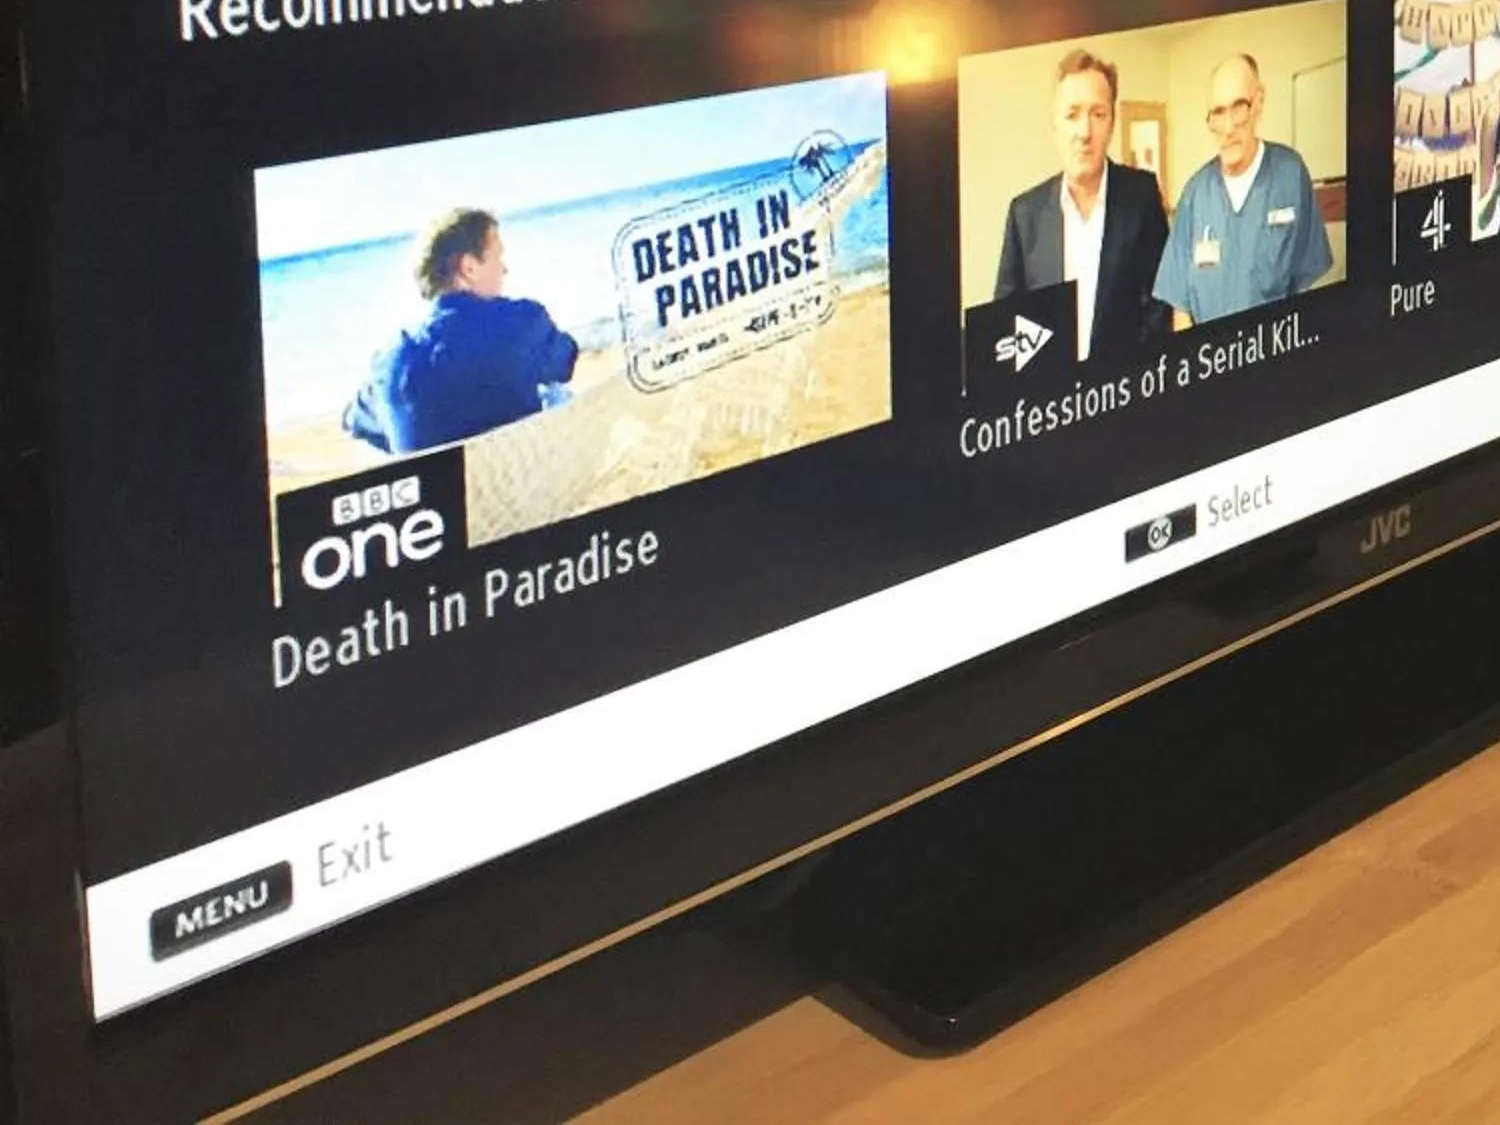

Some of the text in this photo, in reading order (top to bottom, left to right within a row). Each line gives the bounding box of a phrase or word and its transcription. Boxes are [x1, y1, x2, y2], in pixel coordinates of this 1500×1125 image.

[631, 189, 791, 284] DEATH IN
[1419, 188, 1452, 252] 4
[654, 229, 821, 328] PARADISE
[1391, 279, 1435, 316] Pure
[959, 376, 1131, 458] Confessions
[1140, 354, 1168, 399] of
[1177, 358, 1190, 387] a
[1198, 324, 1265, 381] Serial
[337, 478, 420, 524] BBC
[1150, 474, 1274, 545] OK Select
[1359, 502, 1413, 555] JVC
[301, 507, 445, 590] one
[271, 529, 660, 689] Death in Paradise
[174, 820, 393, 939] MENU Exit
